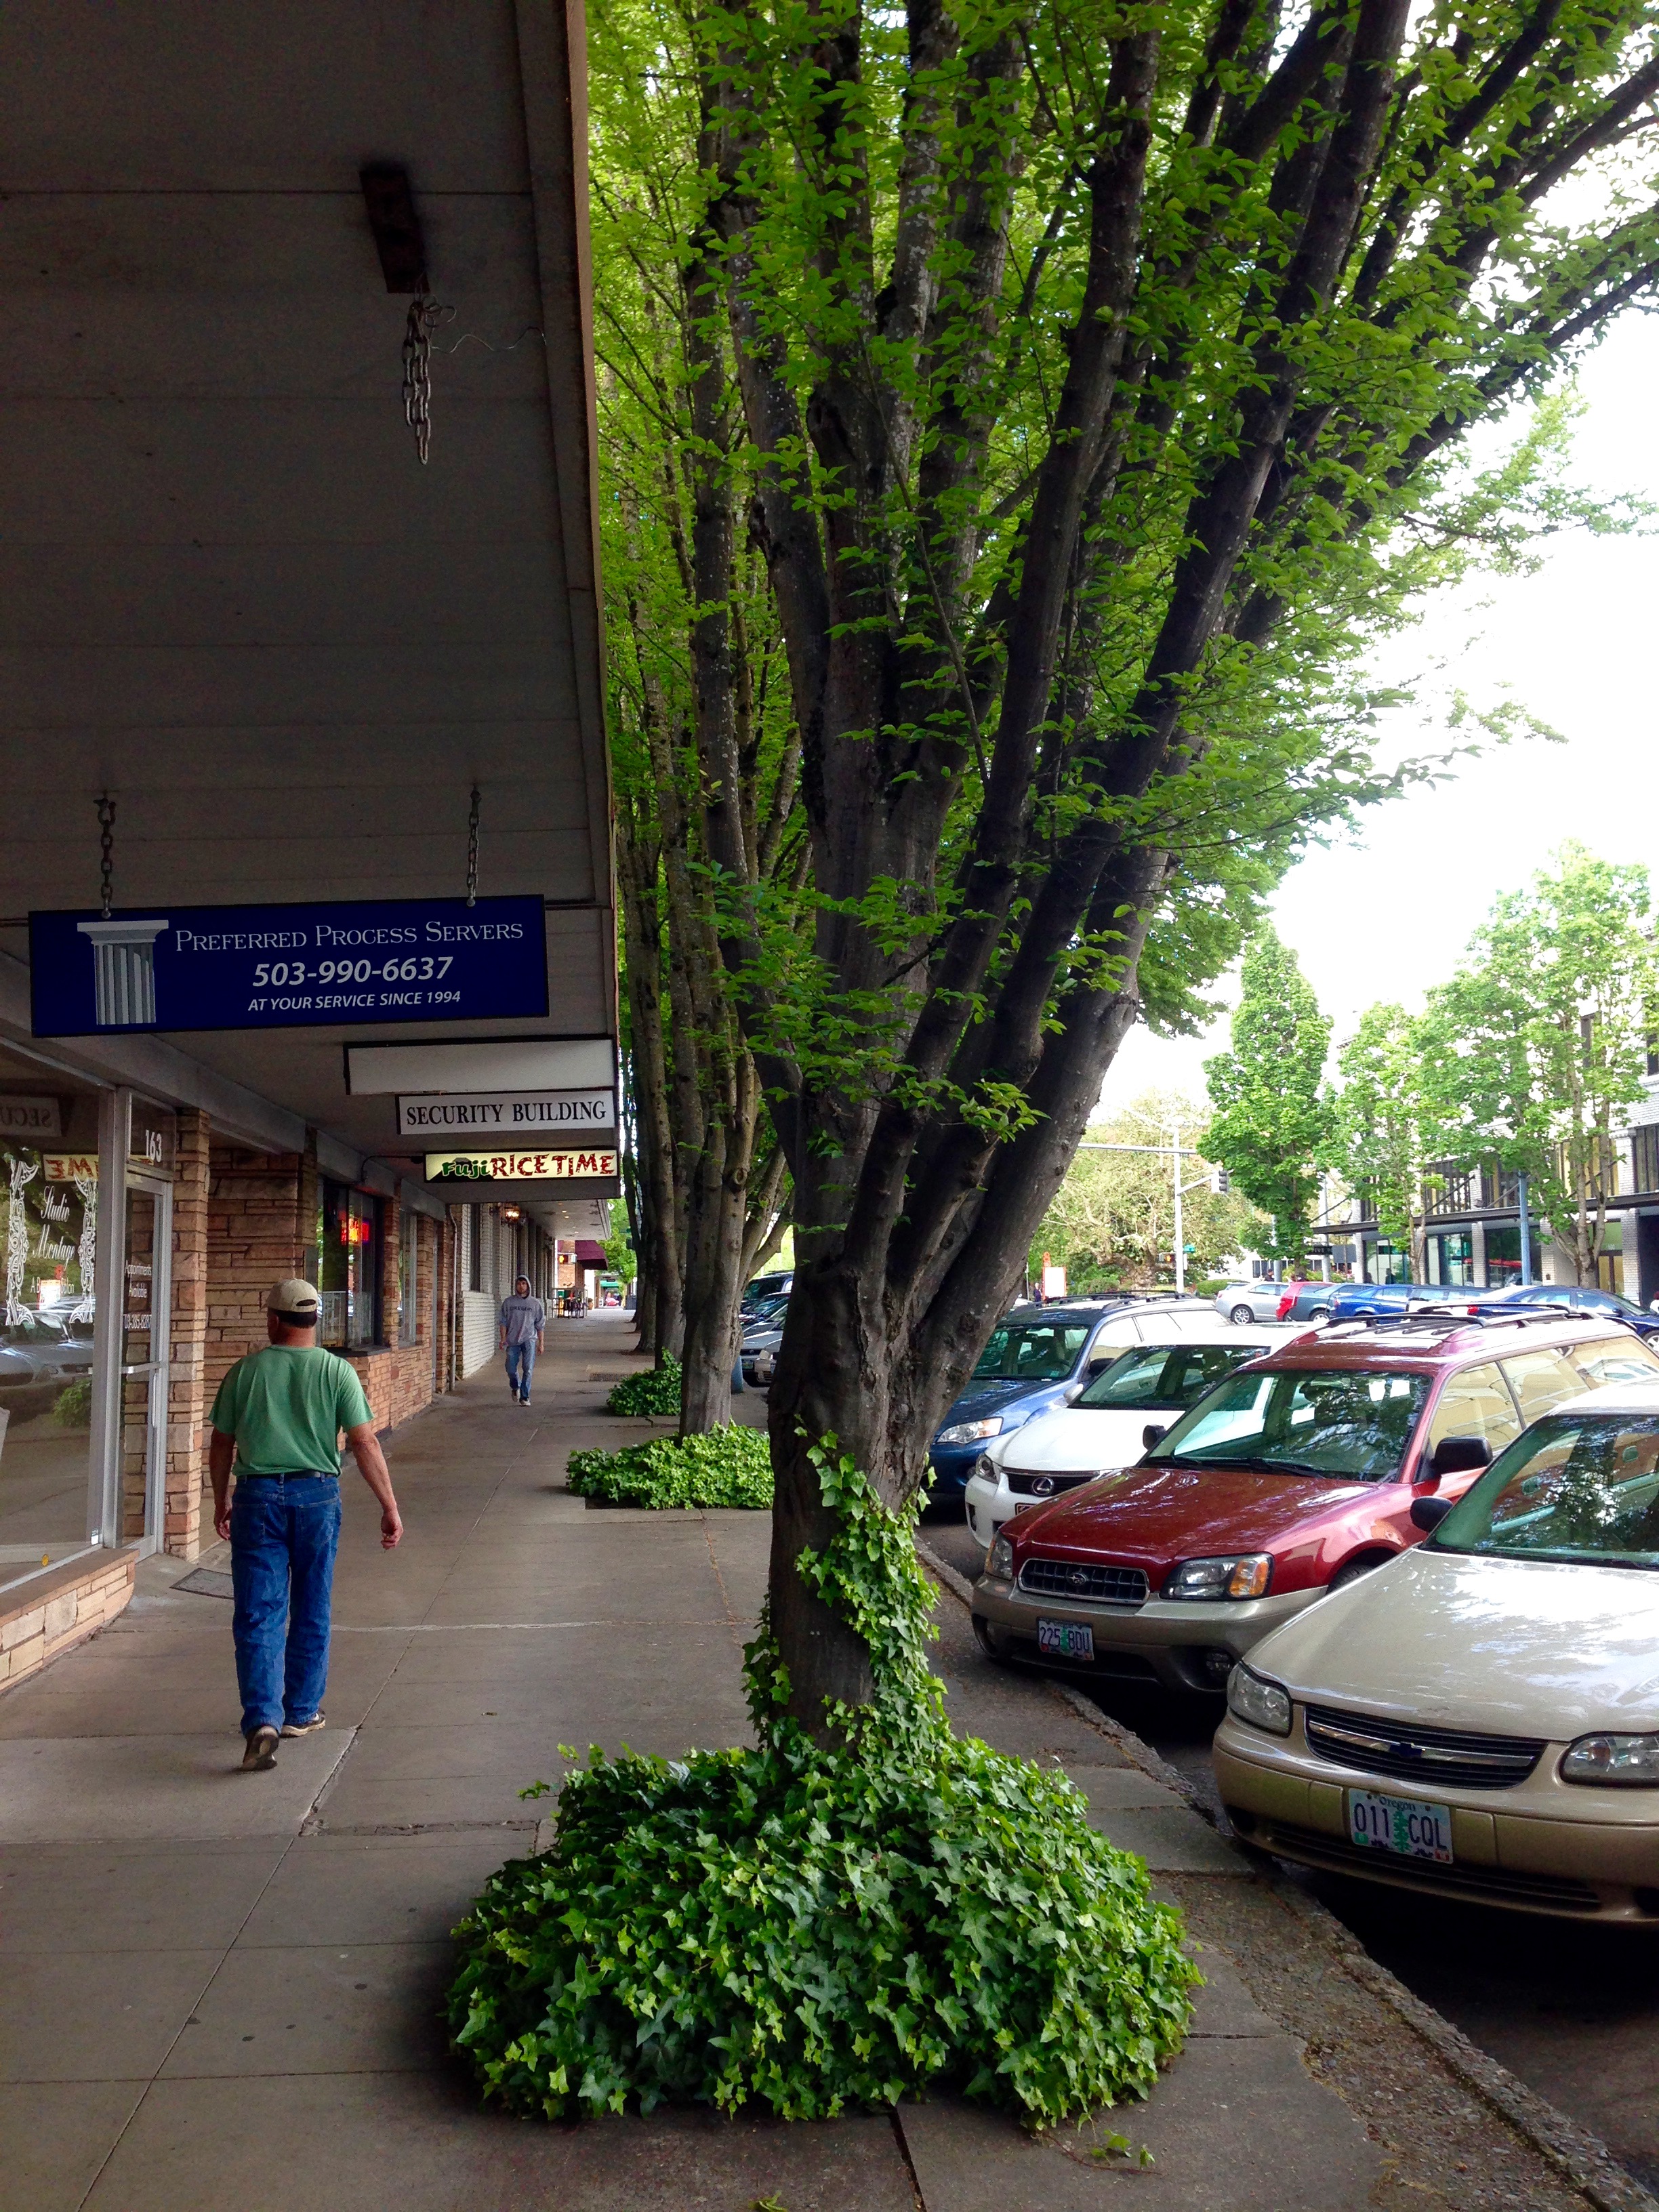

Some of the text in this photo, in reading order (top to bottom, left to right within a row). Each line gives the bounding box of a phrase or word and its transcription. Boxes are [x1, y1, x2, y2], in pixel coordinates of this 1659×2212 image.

[176, 920, 524, 951] PREFERRED PROCESS SERVERS
[252, 956, 453, 987] 503-990-6637
[247, 990, 462, 1011] AT YOUR SERVICE SINCE 1994
[407, 1100, 607, 1126] SECURITY BUILDING
[145, 1129, 163, 1163] 163
[441, 1159, 491, 1179] Fuji
[40, 1185, 70, 1223] Studio
[32, 1223, 75, 1271] Montage
[1039, 1626, 1090, 1651] 225 BDU
[1378, 1795, 1416, 1812] Oregon
[1354, 1802, 1448, 1851] 011 CQL
